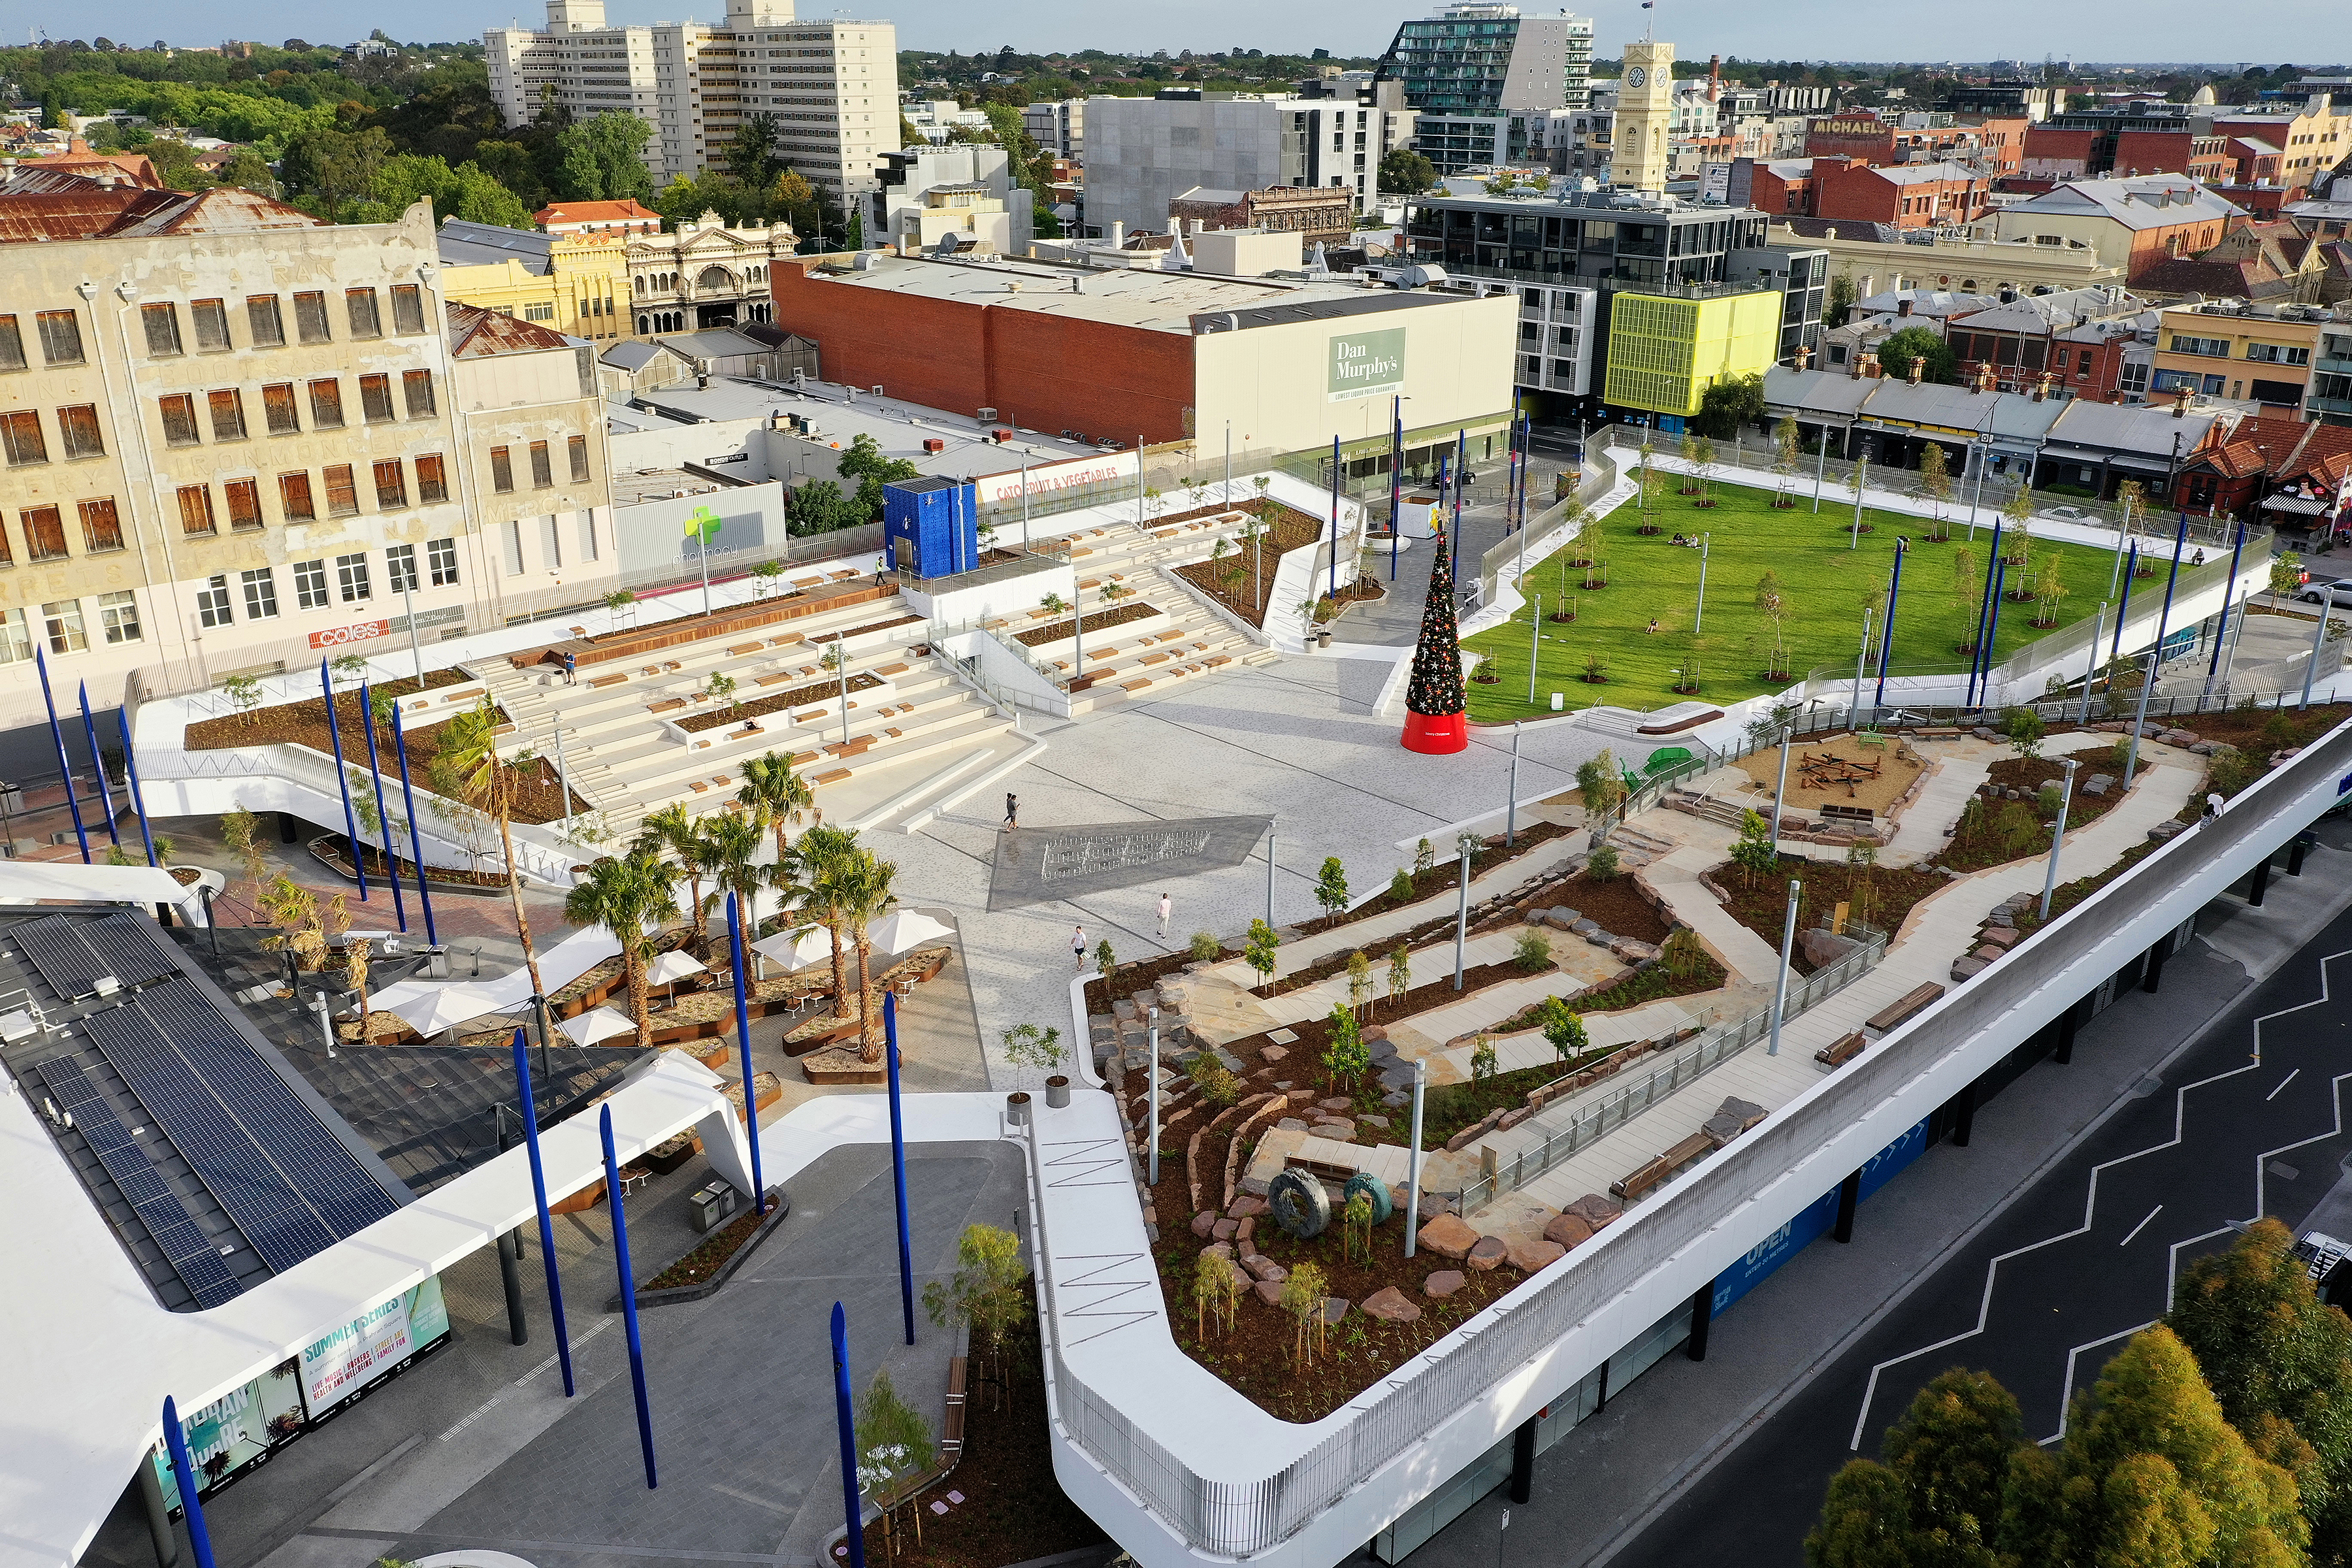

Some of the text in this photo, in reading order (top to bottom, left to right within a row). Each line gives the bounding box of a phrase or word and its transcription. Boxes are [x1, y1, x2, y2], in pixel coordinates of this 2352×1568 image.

[1336, 342, 1366, 360] Dan
[290, 357, 306, 375] &
[1335, 355, 1397, 381] Murphy's
[1335, 391, 1350, 400] LOWEST
[1375, 384, 1396, 393] GUARANTEE
[997, 466, 1117, 500] CATO FRUIT & VEGETABLES
[486, 488, 605, 524] MERCERY
[672, 544, 738, 567] pharmacy
[319, 621, 380, 646] coles
[1746, 1219, 1792, 1266] OPEN
[304, 1298, 399, 1363] SUMMER SERIES
[363, 1328, 383, 1342] Prahran
[384, 1315, 402, 1330] Square
[312, 1379, 323, 1393] LIVE
[324, 1368, 342, 1383] MUSIC
[347, 1350, 370, 1371] BUSKERS
[374, 1335, 393, 1352] STREET
[394, 1329, 404, 1340] ART
[312, 1384, 333, 1401] HEALTH
[333, 1375, 344, 1388] AND
[344, 1358, 373, 1381] WELLBEING
[376, 1343, 395, 1360] FAMILY
[395, 1336, 406, 1348] FUN
